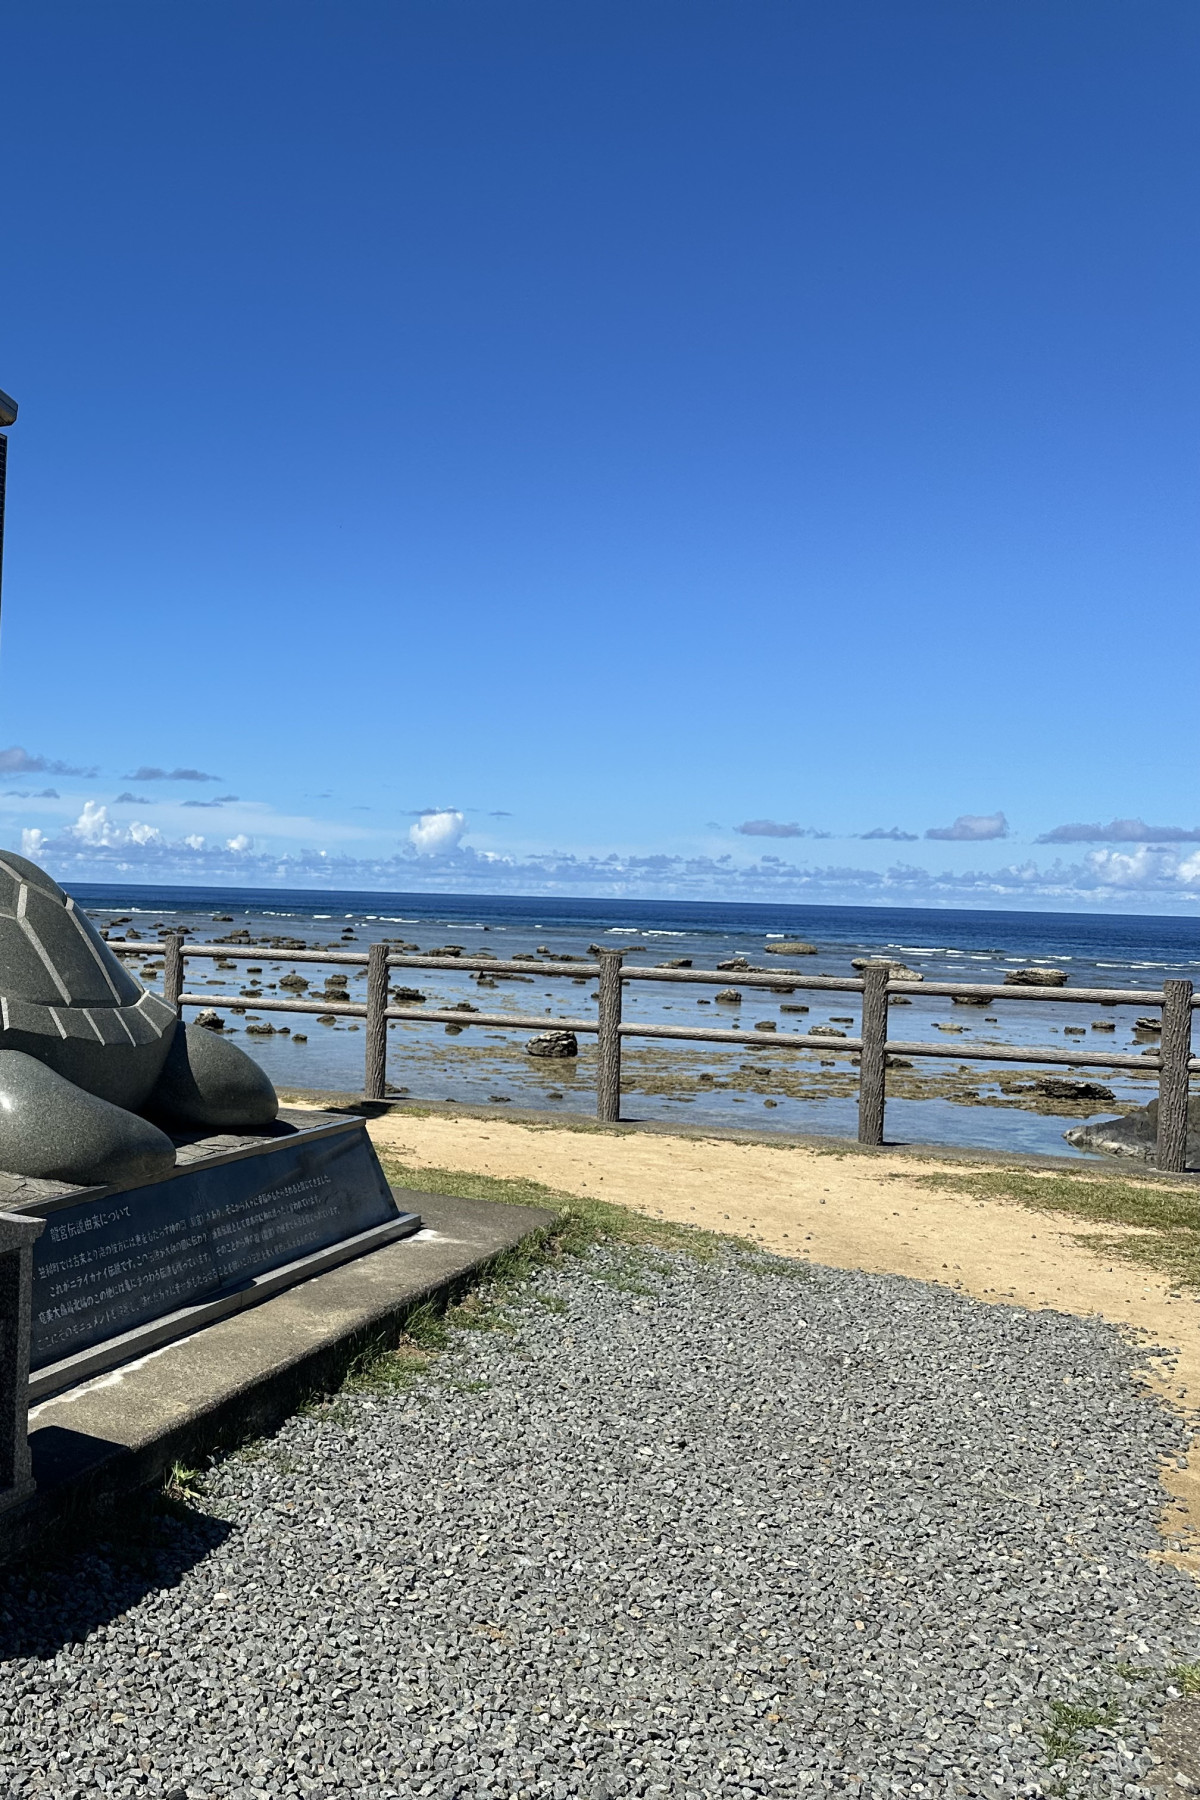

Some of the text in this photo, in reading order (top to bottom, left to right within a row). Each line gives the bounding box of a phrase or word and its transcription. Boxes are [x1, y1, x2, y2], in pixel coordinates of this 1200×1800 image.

[49, 1203, 132, 1244] 龍宮伝説由来について
